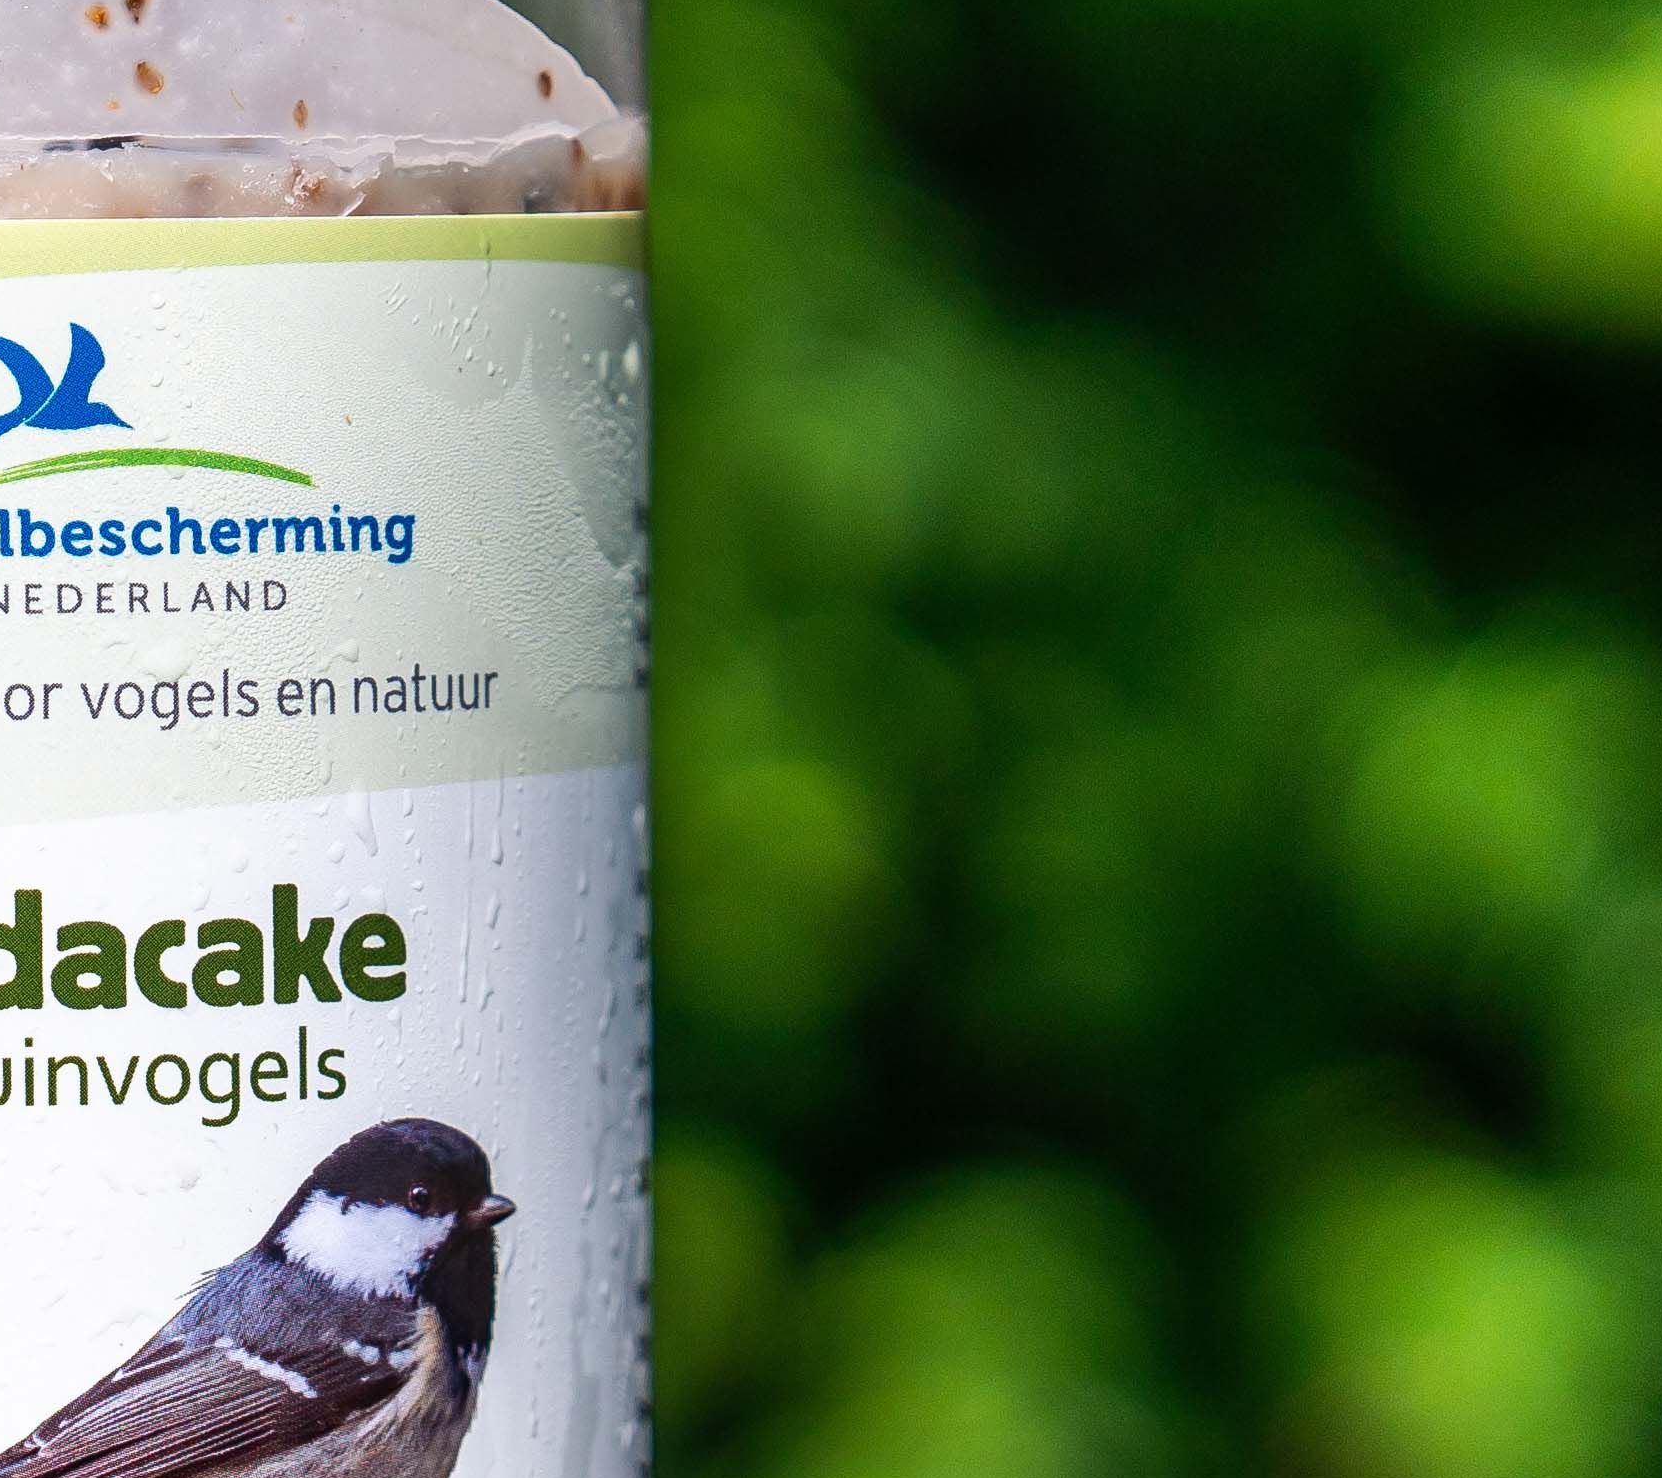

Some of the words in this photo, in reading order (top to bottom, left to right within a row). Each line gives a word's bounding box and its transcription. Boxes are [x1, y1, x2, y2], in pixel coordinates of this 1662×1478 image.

[81, 668, 259, 731] vogels
[277, 679, 335, 716] en
[354, 664, 498, 713] natuur
